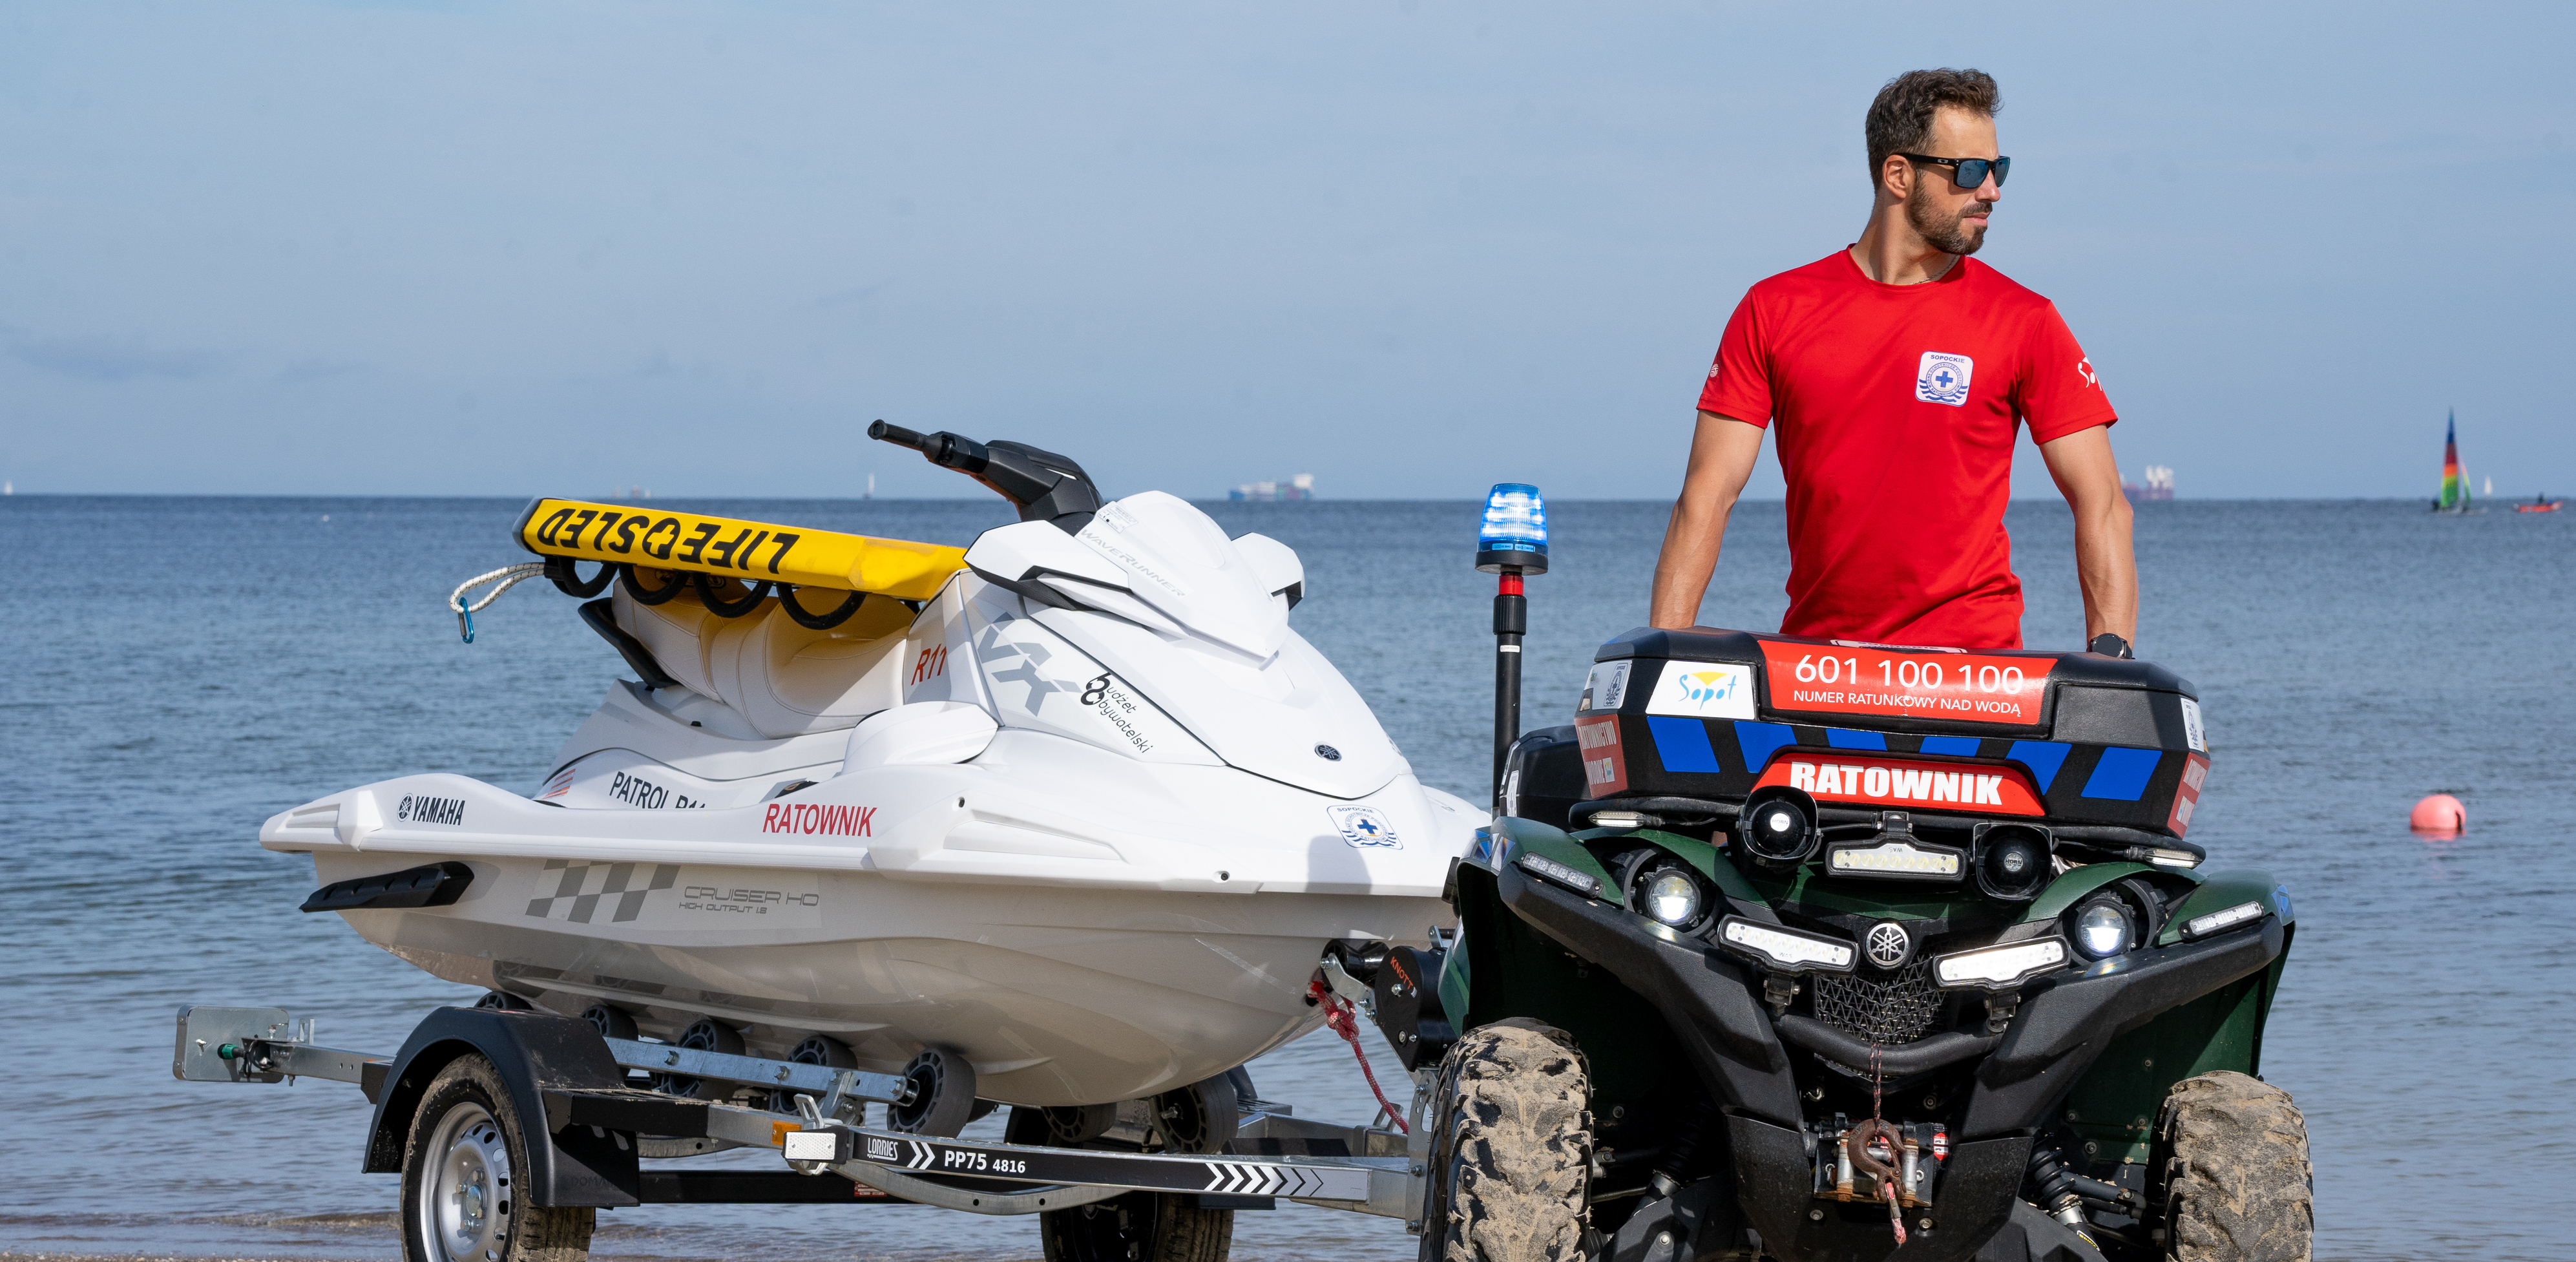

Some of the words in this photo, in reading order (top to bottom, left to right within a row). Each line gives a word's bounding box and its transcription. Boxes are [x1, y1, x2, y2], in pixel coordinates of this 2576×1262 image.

[1931, 354, 1965, 363] SOPOCKIE
[910, 644, 947, 686] R11
[1796, 655, 1856, 684] 601
[1878, 660, 1943, 689] 100
[1958, 665, 2024, 695] 100
[1679, 674, 1737, 711] Sopot
[1794, 691, 1845, 703] NUMER
[1848, 693, 1937, 709] RATUNKOWY
[1941, 699, 1972, 711] NAD
[1975, 700, 2021, 717] WODĄ
[1790, 762, 2003, 805] RATOWNIK
[412, 795, 465, 825] YAMAHA
[762, 803, 877, 837] RATOWNIK
[679, 902, 702, 910] HIGH
[706, 903, 753, 914] OUTPUT
[684, 885, 781, 905] CRUISER
[786, 892, 819, 906] HO
[1390, 956, 1414, 990] KNOTT
[867, 1137, 898, 1161] LORRIES
[944, 1150, 987, 1170] PP75
[992, 1159, 1026, 1173] 4816
